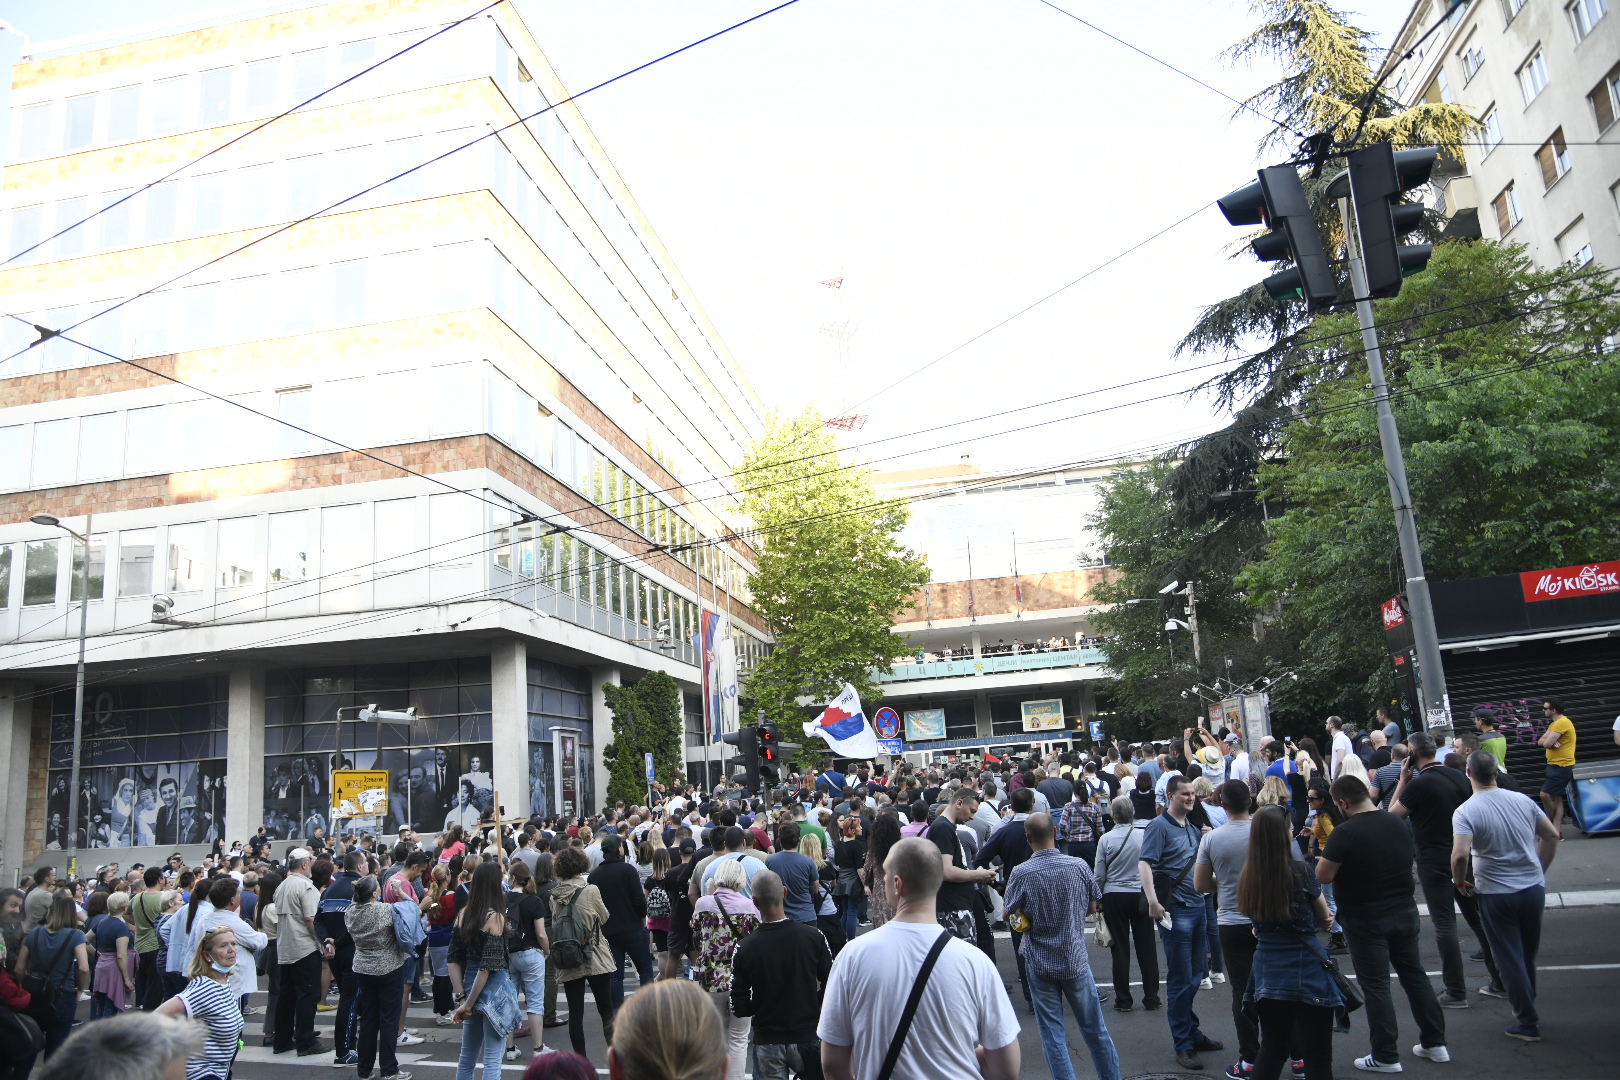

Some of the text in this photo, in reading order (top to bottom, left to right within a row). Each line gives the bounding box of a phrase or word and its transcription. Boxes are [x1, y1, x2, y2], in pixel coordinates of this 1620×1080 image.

[1535, 567, 1619, 595] Moj KIOSK
[997, 659, 1018, 668] ДЕЧЈИ
[1052, 654, 1078, 663] ЦЕНТАР
[923, 733, 1049, 751] ДЕЧЈИ КУЛТУРНИ ЦЕНТАР БЕОГРАД
